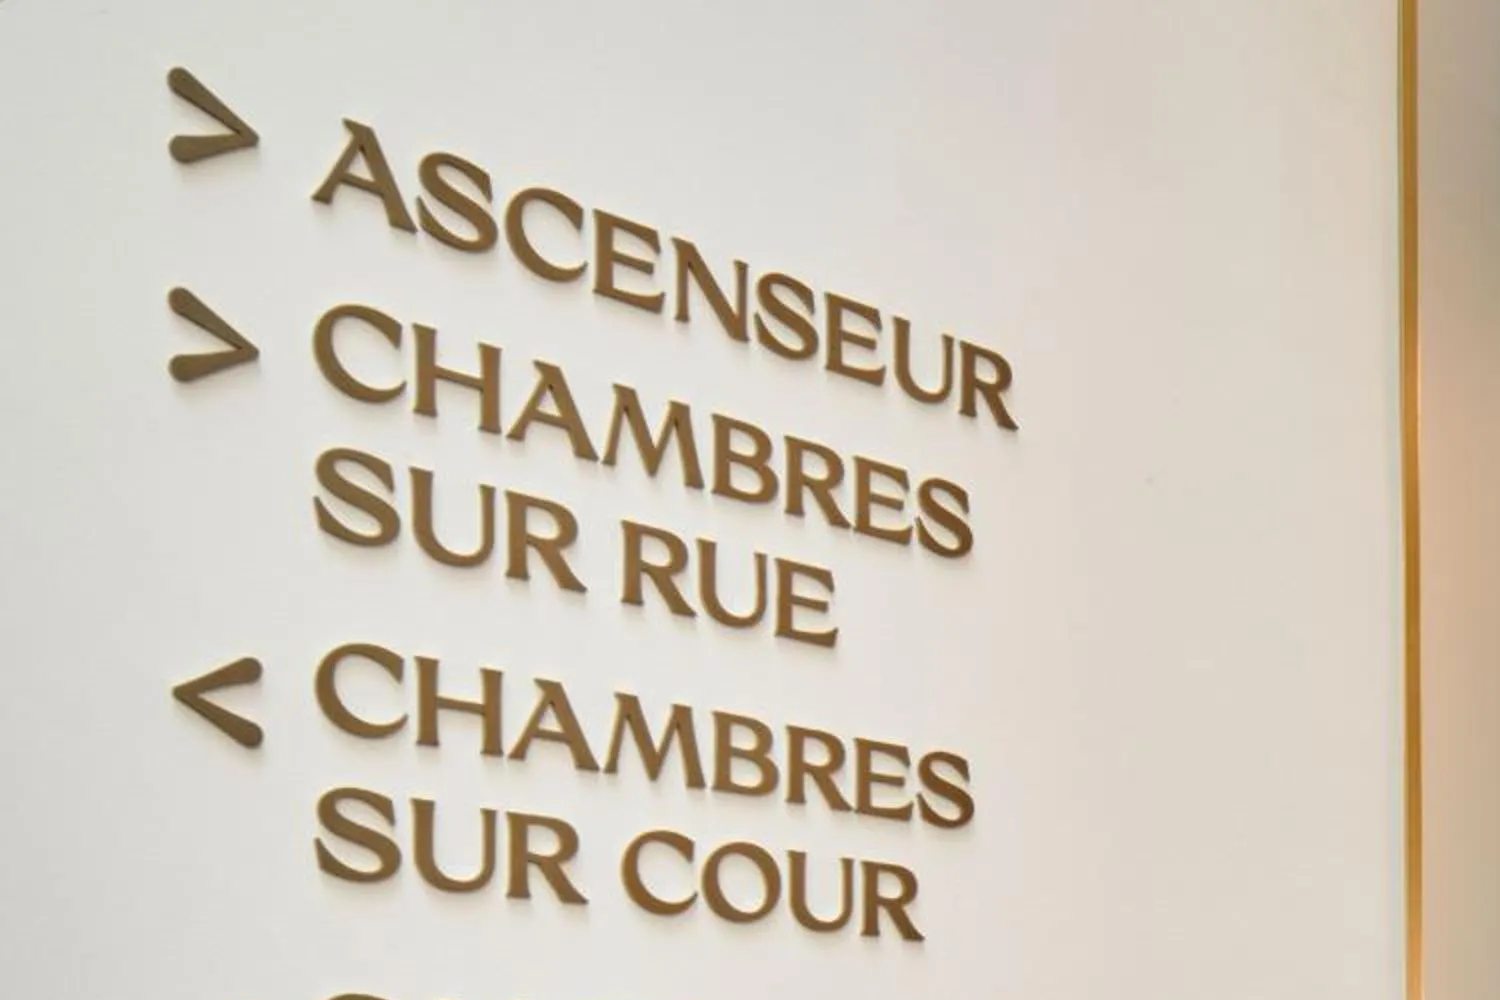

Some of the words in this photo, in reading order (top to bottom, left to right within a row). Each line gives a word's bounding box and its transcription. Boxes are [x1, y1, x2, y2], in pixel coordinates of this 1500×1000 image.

[312, 117, 1020, 433] ASCENSEUR
[313, 304, 974, 560] CHAMBRES
[313, 448, 588, 594] SUR
[621, 520, 839, 649] RUE
[315, 643, 976, 831] CHAMBRES
[314, 787, 589, 906] SUR
[622, 830, 925, 944] COUR
